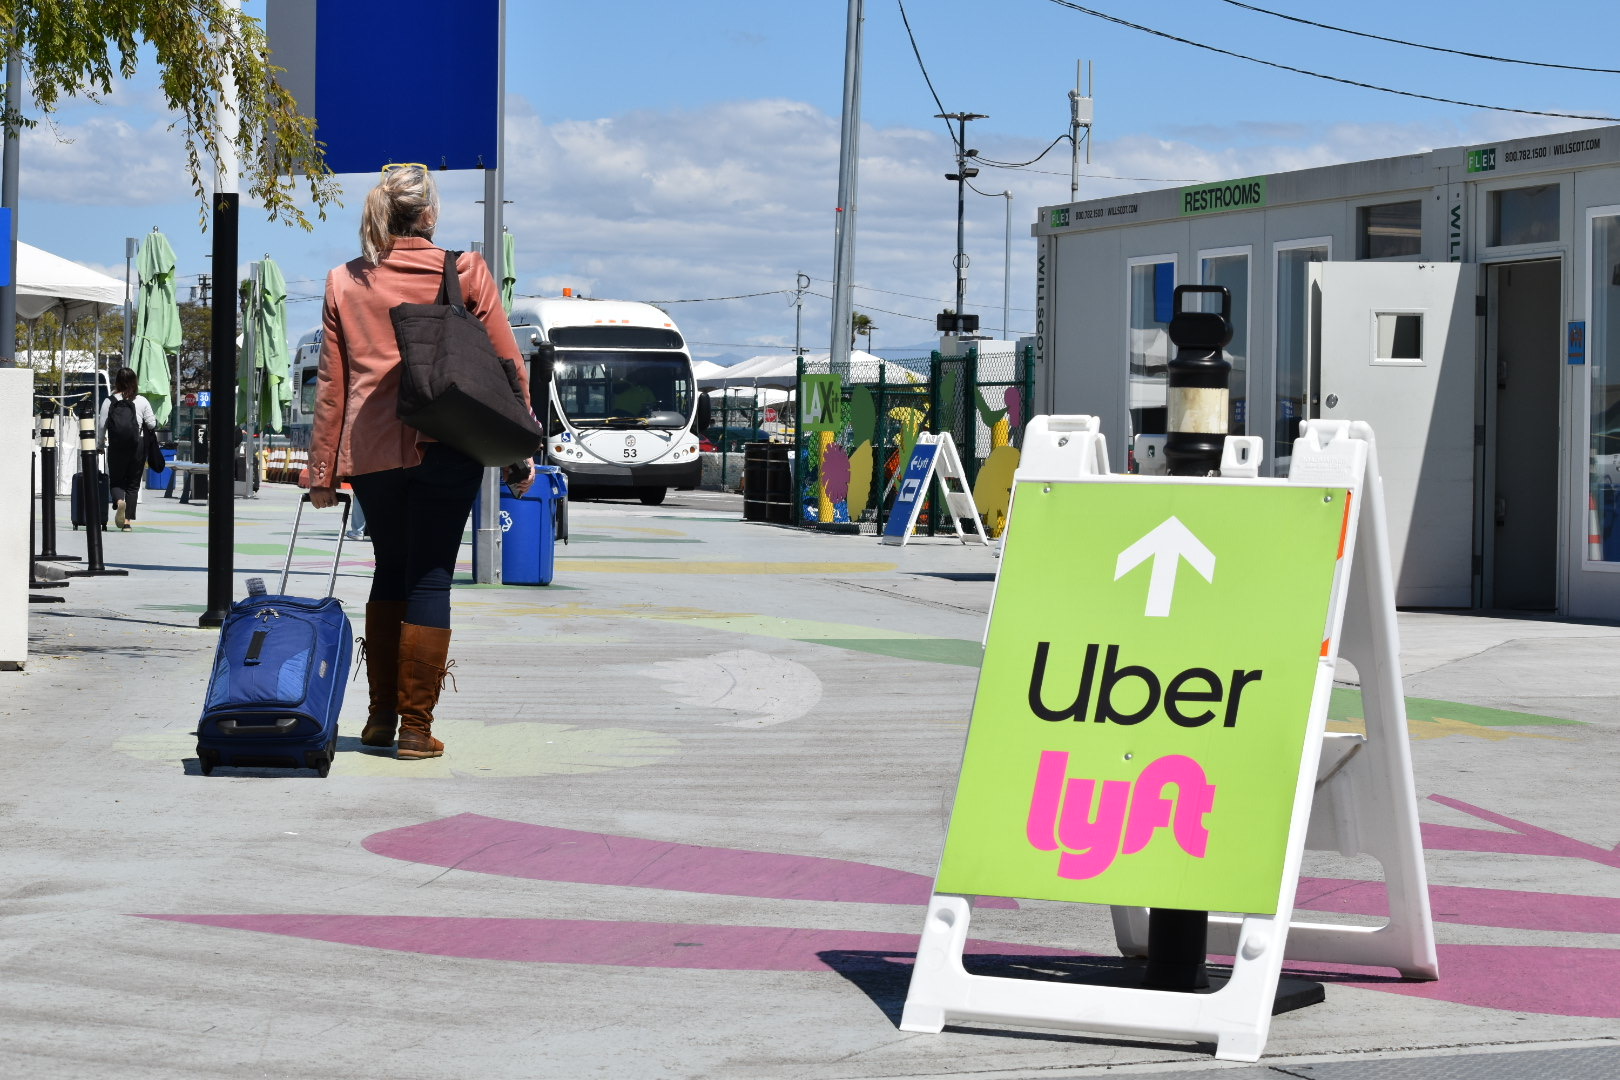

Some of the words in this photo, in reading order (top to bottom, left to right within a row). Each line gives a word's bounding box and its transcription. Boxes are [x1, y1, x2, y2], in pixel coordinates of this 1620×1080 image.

[1468, 153, 1496, 169] FLEX
[1505, 147, 1547, 163] 800.782.1500
[1553, 138, 1601, 156] WILLSCOT.COM
[1184, 182, 1261, 213] RESTROOMS
[1051, 211, 1069, 225] FLEX
[1037, 254, 1046, 364] WILLSCOT
[623, 448, 637, 458] 53
[1028, 641, 1263, 728] Uber
[1026, 750, 1216, 880] lyft
